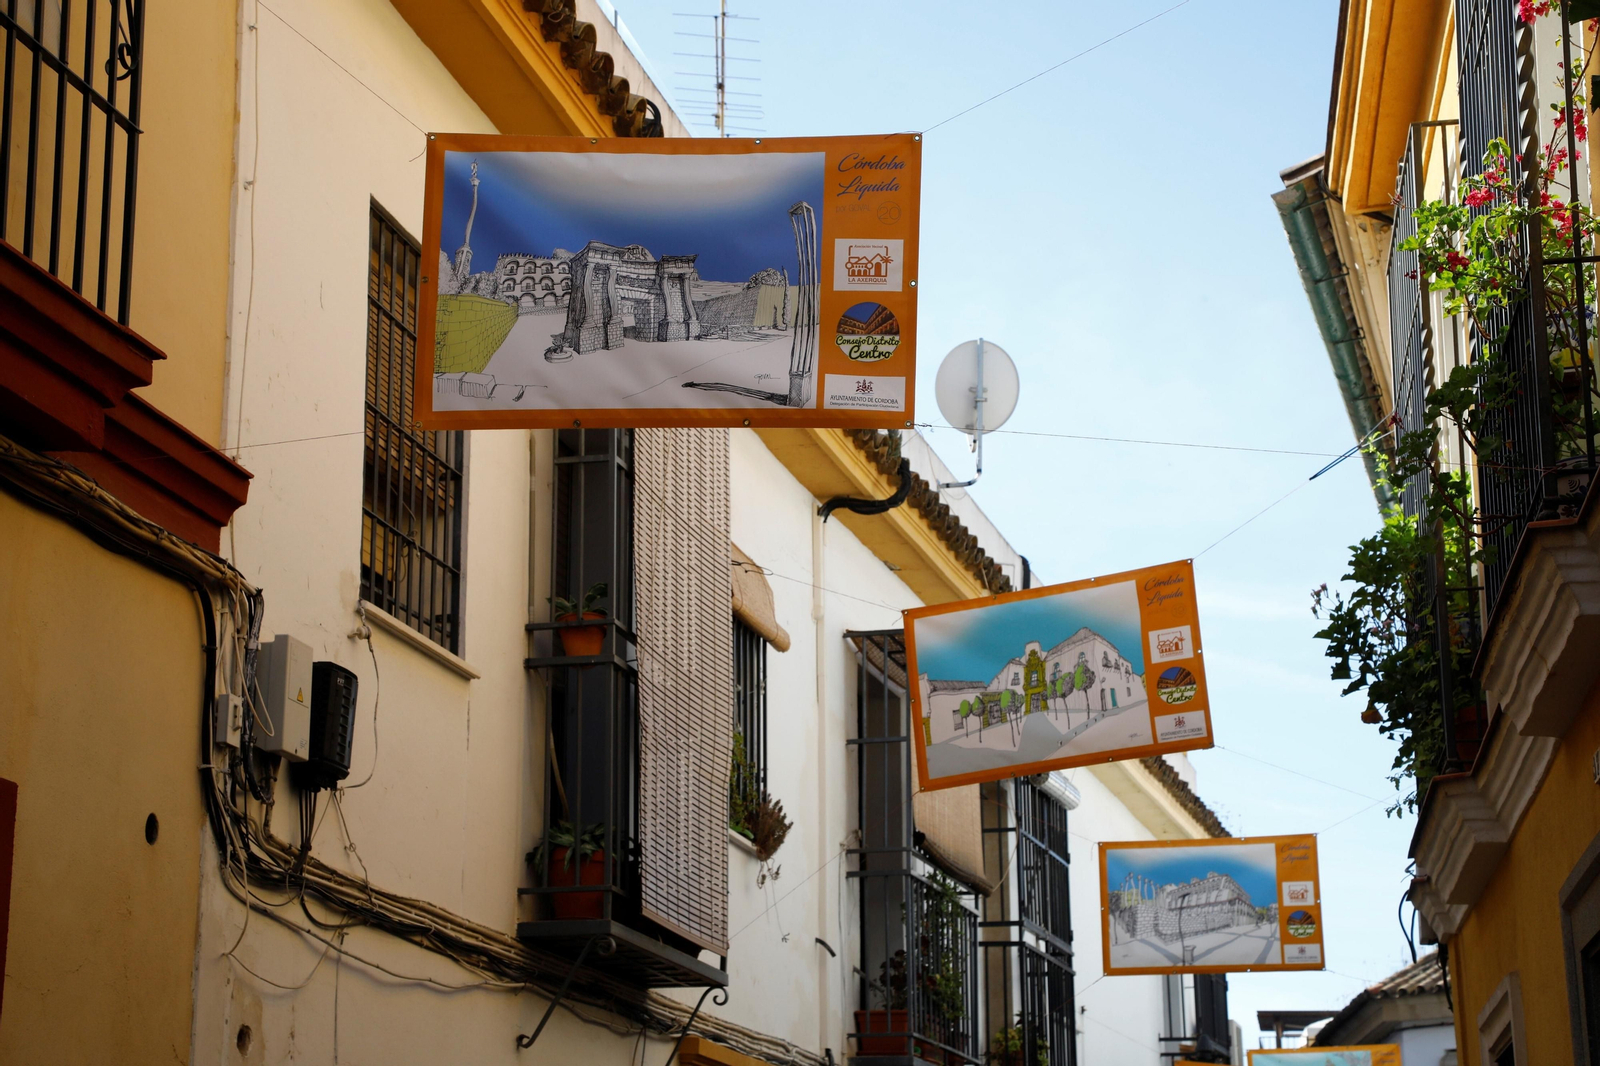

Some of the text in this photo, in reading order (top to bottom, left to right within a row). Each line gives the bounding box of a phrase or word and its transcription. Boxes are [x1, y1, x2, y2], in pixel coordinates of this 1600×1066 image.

[837, 152, 906, 173] Córdoba
[879, 206, 900, 220] 20
[848, 345, 893, 360] Centro
[829, 394, 867, 403] AYUNTAMIENTO
[1166, 692, 1193, 704] Centro
